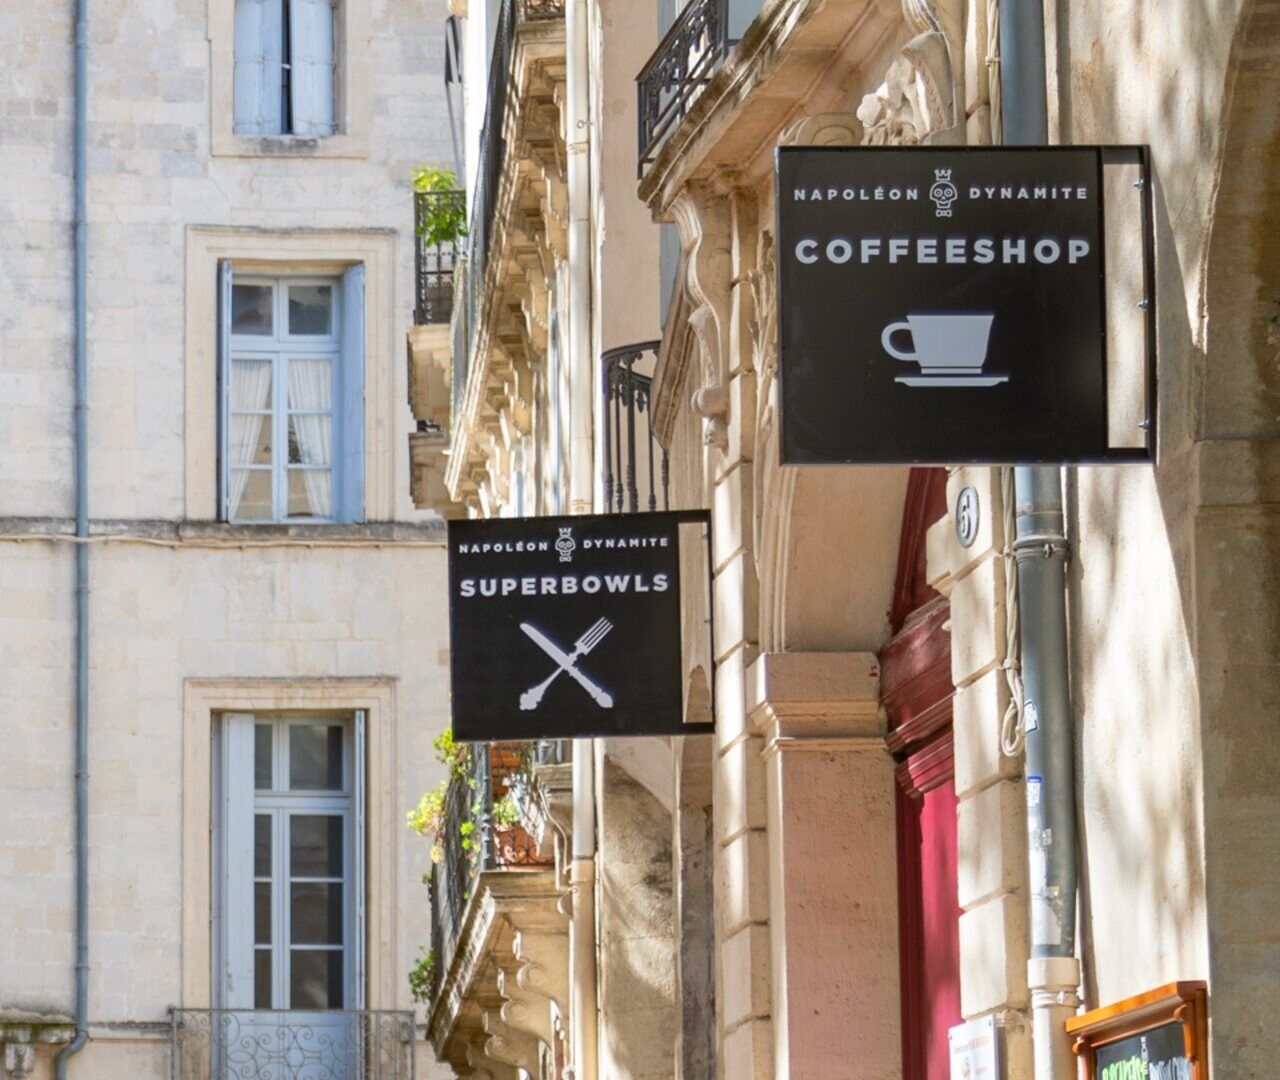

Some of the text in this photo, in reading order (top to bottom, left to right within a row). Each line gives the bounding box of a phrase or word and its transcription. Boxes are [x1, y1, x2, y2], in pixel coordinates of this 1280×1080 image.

[794, 186, 1088, 201] NAPOLÉON DYNAMITE
[794, 239, 1091, 265] COFFEESHOP
[459, 537, 669, 554] NAPOLÉON DYNAMITE
[460, 574, 669, 597] SUPERBOWLS
